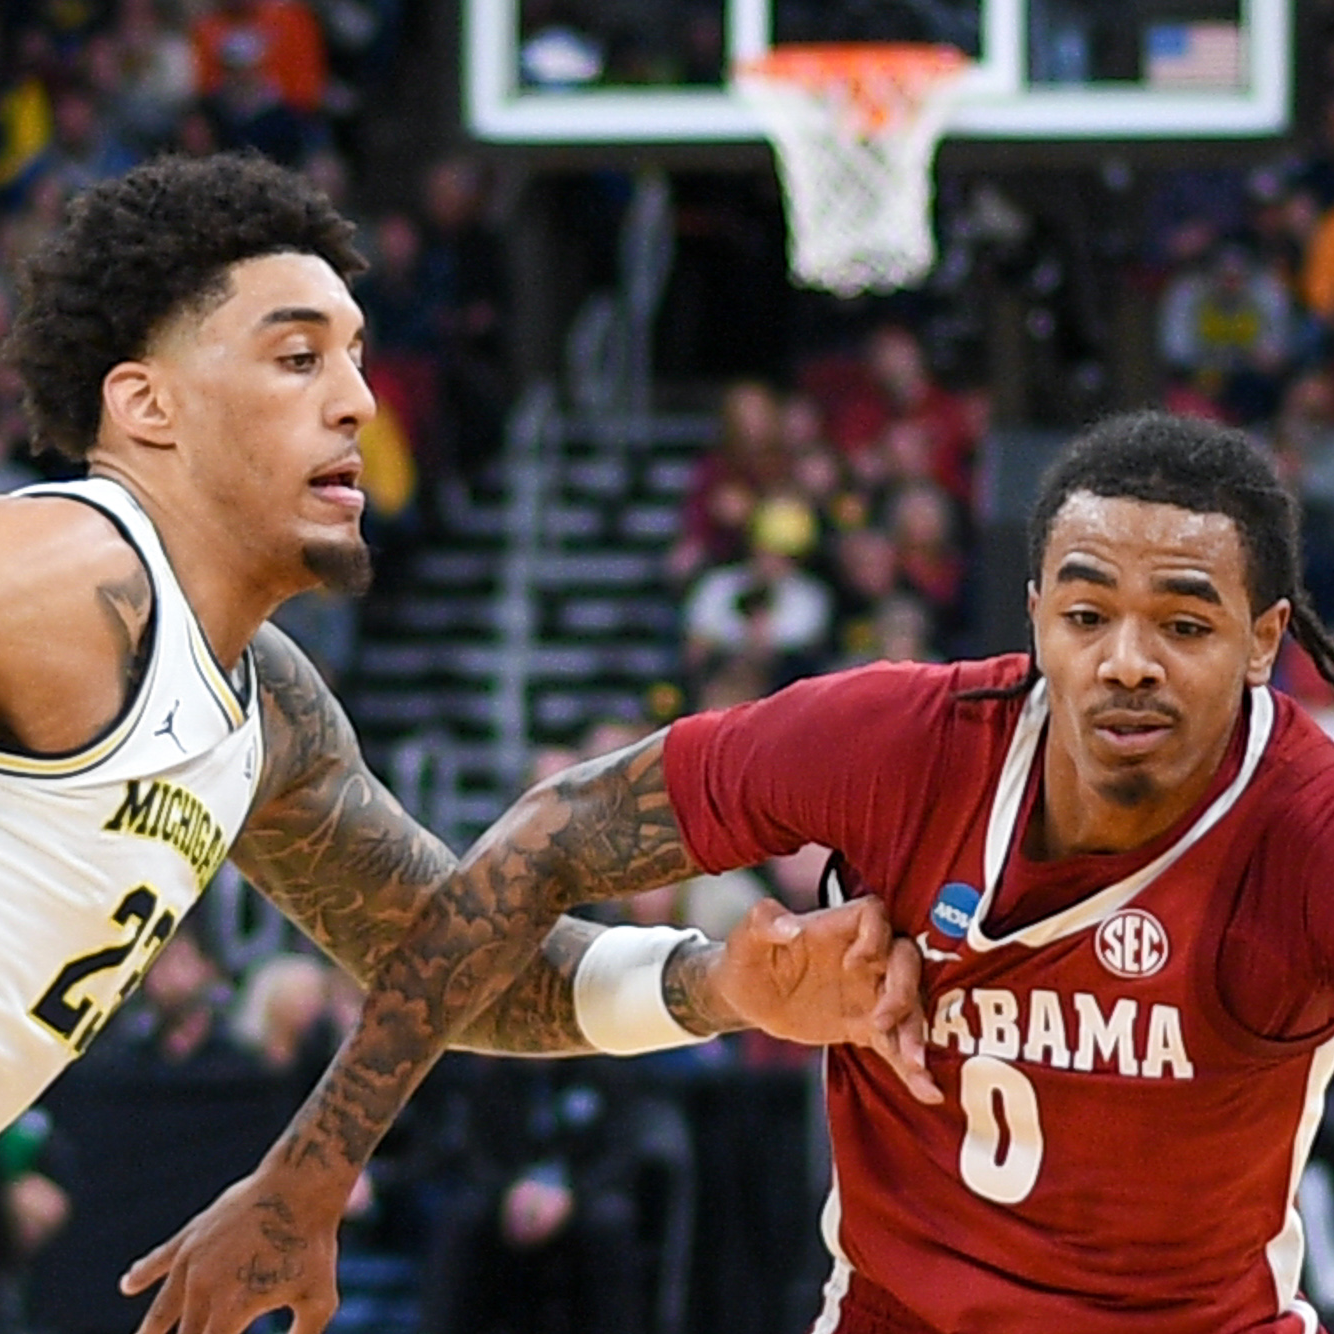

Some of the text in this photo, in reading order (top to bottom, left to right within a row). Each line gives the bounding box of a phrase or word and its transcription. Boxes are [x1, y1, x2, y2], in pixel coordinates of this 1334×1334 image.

[103, 779, 227, 888] MICHIGA
[933, 901, 970, 930] NCA
[1103, 915, 1161, 973] SEC
[923, 986, 1195, 1079] ABAMA
[959, 1055, 1044, 1205] 0
